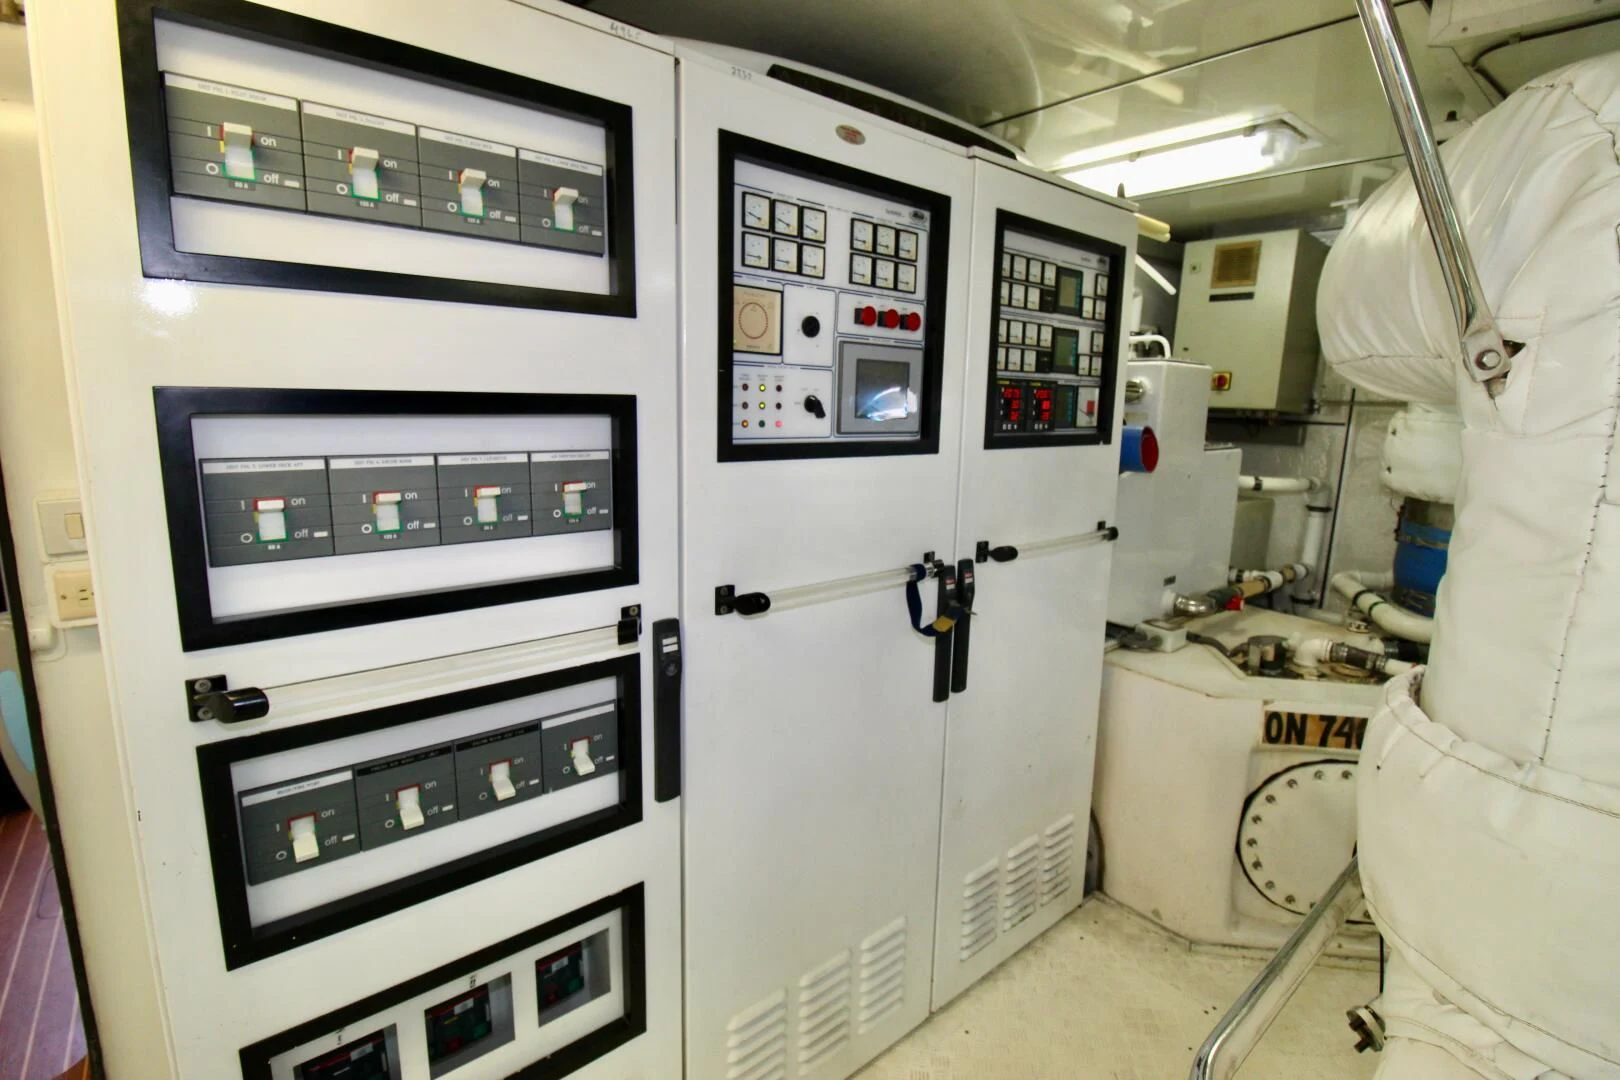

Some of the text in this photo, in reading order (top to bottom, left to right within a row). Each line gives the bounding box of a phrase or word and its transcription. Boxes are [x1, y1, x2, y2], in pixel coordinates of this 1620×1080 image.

[261, 137, 276, 147] on
[384, 159, 397, 169] on
[264, 173, 279, 184] off
[488, 178, 499, 187] on
[386, 193, 399, 202] off
[577, 196, 588, 204] on
[489, 210, 501, 219] off
[579, 225, 589, 233] off
[501, 486, 512, 494] on
[405, 491, 417, 500] on
[291, 497, 306, 505] on
[587, 507, 596, 515] off
[503, 514, 513, 522] off
[407, 520, 419, 530] off
[294, 529, 308, 539] off
[1265, 711, 1308, 746] ON
[594, 756, 604, 765] off
[425, 780, 437, 790] on
[516, 780, 526, 789] off
[321, 809, 335, 818] on
[427, 806, 439, 816] off
[325, 835, 338, 846] off
